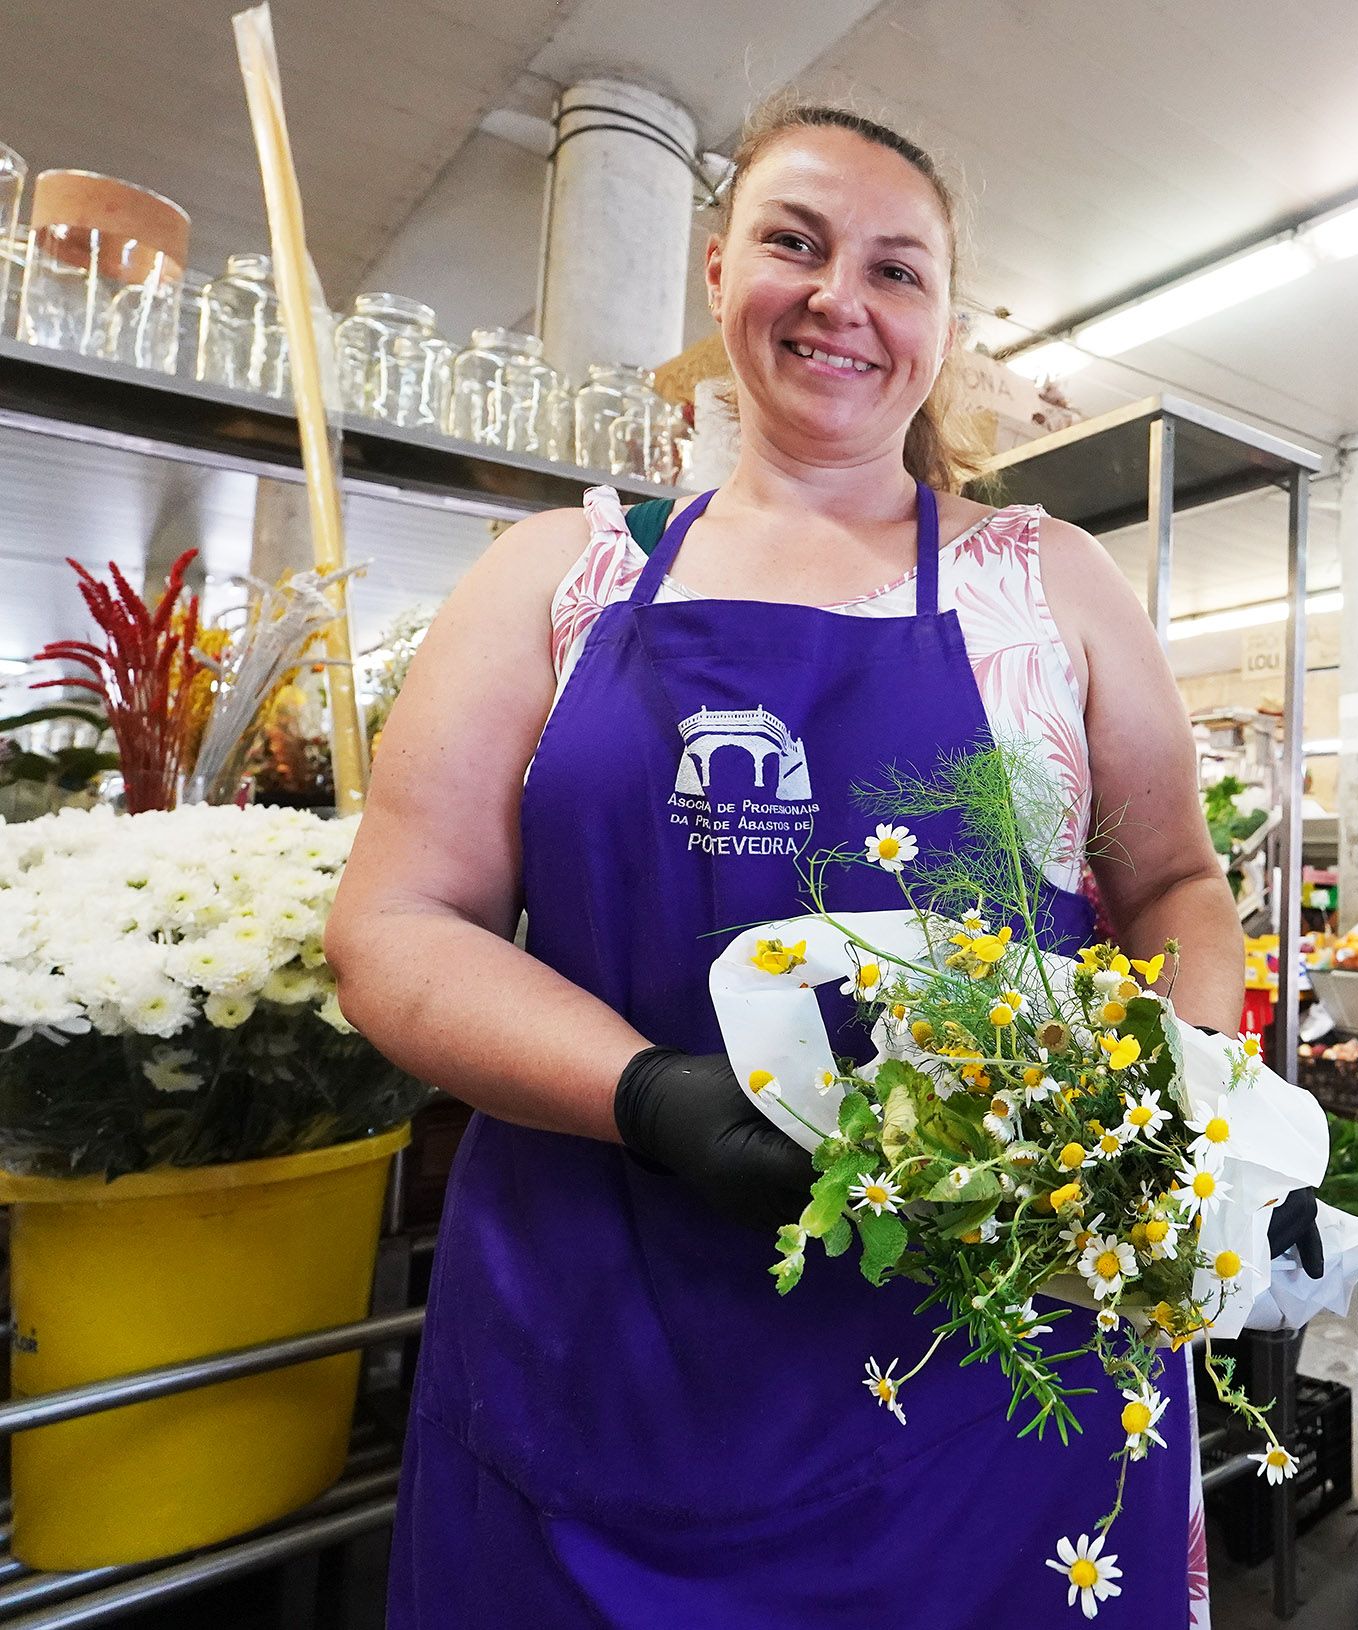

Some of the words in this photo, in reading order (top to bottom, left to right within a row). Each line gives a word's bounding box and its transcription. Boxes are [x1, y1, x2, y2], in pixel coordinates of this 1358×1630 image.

[1248, 653, 1280, 671] LOLI
[667, 792, 712, 813] ASOCIA
[717, 803, 736, 813] DE
[670, 814, 689, 826] DA
[713, 820, 730, 830] DE
[738, 815, 790, 831] ABASTOS
[794, 821, 811, 831] DE
[687, 832, 799, 856] POTEVEDRA
